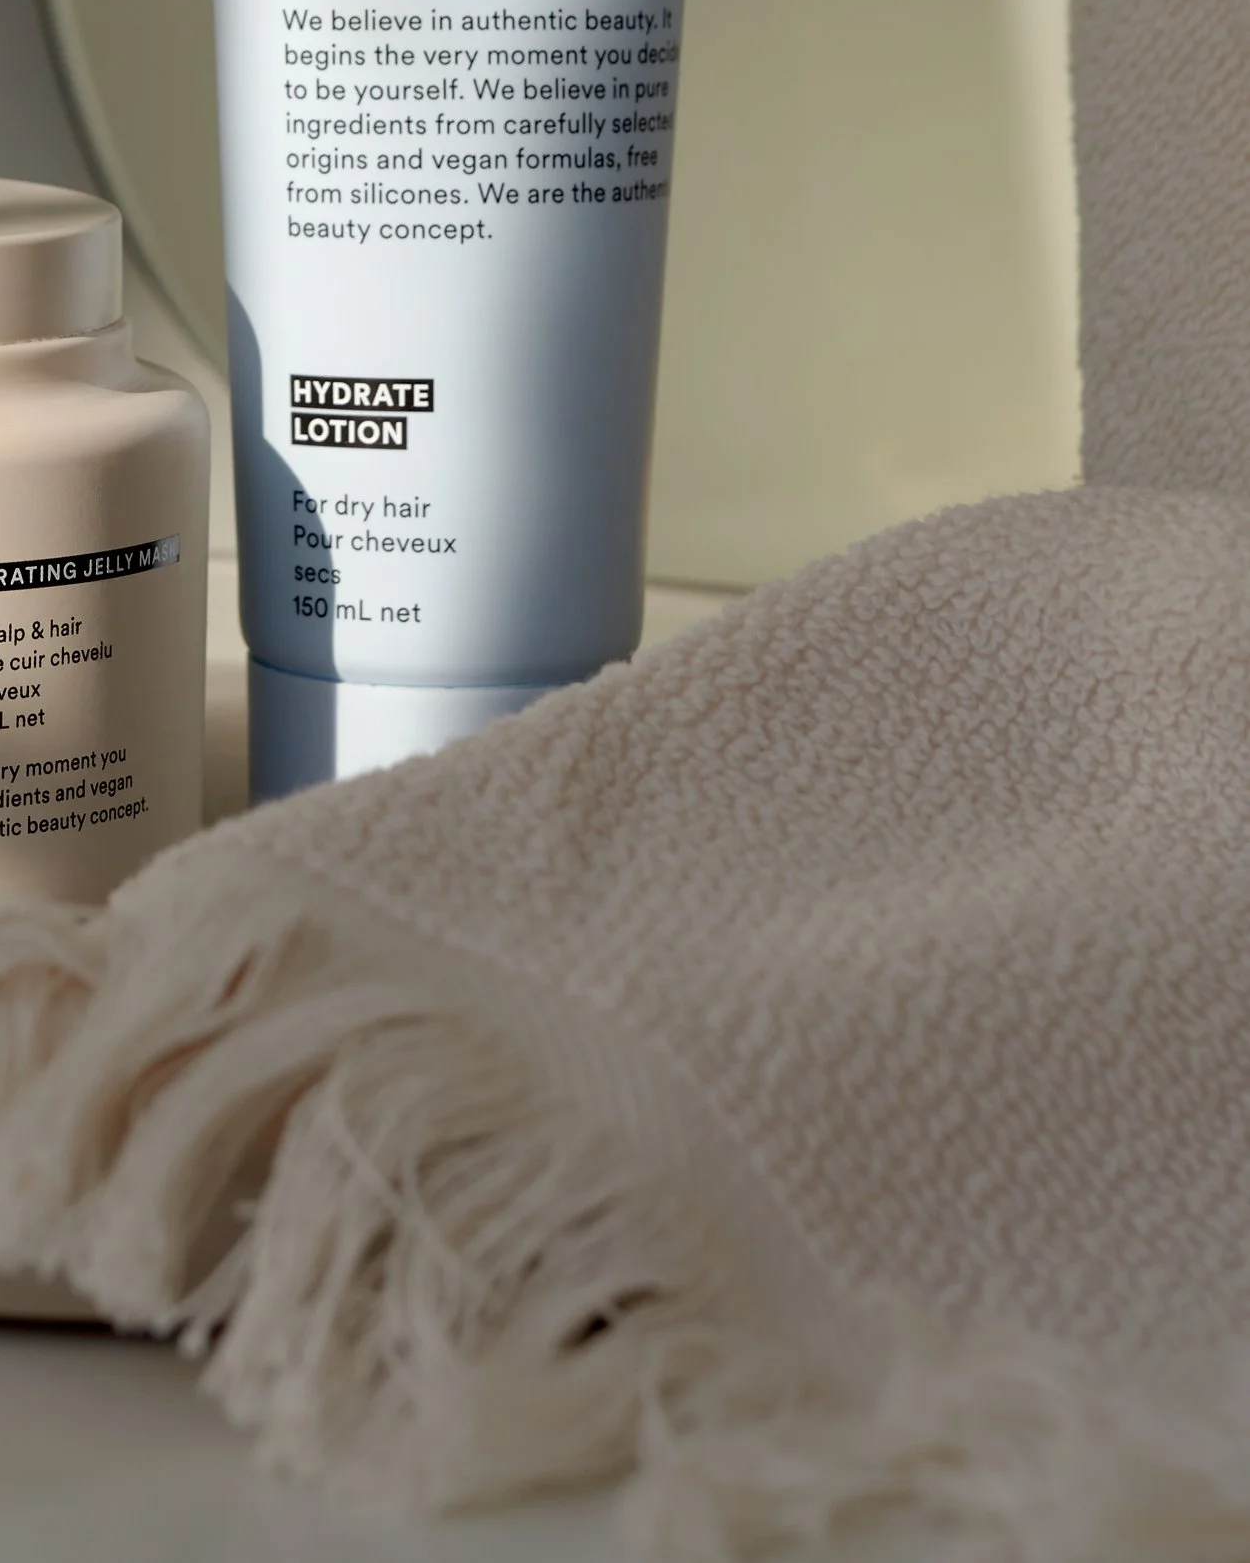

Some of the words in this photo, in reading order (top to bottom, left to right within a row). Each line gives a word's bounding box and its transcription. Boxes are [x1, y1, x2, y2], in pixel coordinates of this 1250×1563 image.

[283, 10, 322, 31] We
[332, 9, 422, 31] believe
[432, 9, 451, 30] in
[462, 9, 576, 30] authentic
[586, 9, 657, 34] beauty.
[661, 9, 673, 30] It
[285, 44, 365, 71] begins
[374, 44, 414, 65] the
[424, 50, 478, 70] very
[488, 46, 587, 65] moment
[595, 49, 631, 70] you
[285, 80, 307, 99] to
[316, 78, 345, 100] be
[354, 78, 463, 105] yourself.
[473, 79, 514, 100] We
[524, 78, 605, 100] believe
[613, 77, 629, 99] in
[635, 81, 668, 103] pure
[287, 112, 426, 140] ingredients
[435, 113, 494, 134] from
[504, 113, 605, 138] carefully
[287, 148, 367, 174] origins
[377, 148, 422, 169] and
[432, 154, 507, 175] vegan
[516, 147, 620, 170] formulas,
[626, 146, 658, 167] free
[287, 181, 341, 203] from
[351, 182, 468, 204] silicones.
[478, 183, 519, 204] We
[528, 188, 564, 204] are
[572, 182, 605, 203] the
[289, 215, 371, 244] beauty
[380, 220, 492, 244] concept.
[293, 379, 429, 408] HYDRATE
[294, 417, 402, 445] LOTION
[294, 490, 328, 513] For
[335, 494, 374, 522] dry
[384, 496, 430, 518] hair
[294, 525, 343, 549] Pour
[351, 530, 456, 553] cheveux
[83, 552, 134, 577] JELLY
[295, 566, 341, 584] secs
[293, 595, 328, 618] 150
[337, 599, 371, 621] mL
[381, 604, 420, 623] net
[32, 621, 44, 639] &
[50, 617, 82, 638] hair
[10, 650, 45, 671] cuir
[50, 641, 112, 666] chevelu
[16, 709, 45, 727] net
[26, 751, 96, 777] moment
[101, 749, 126, 771] you
[55, 779, 85, 802] and
[90, 775, 132, 797] vegan
[28, 812, 86, 834] beauty
[90, 797, 148, 824] concept.
